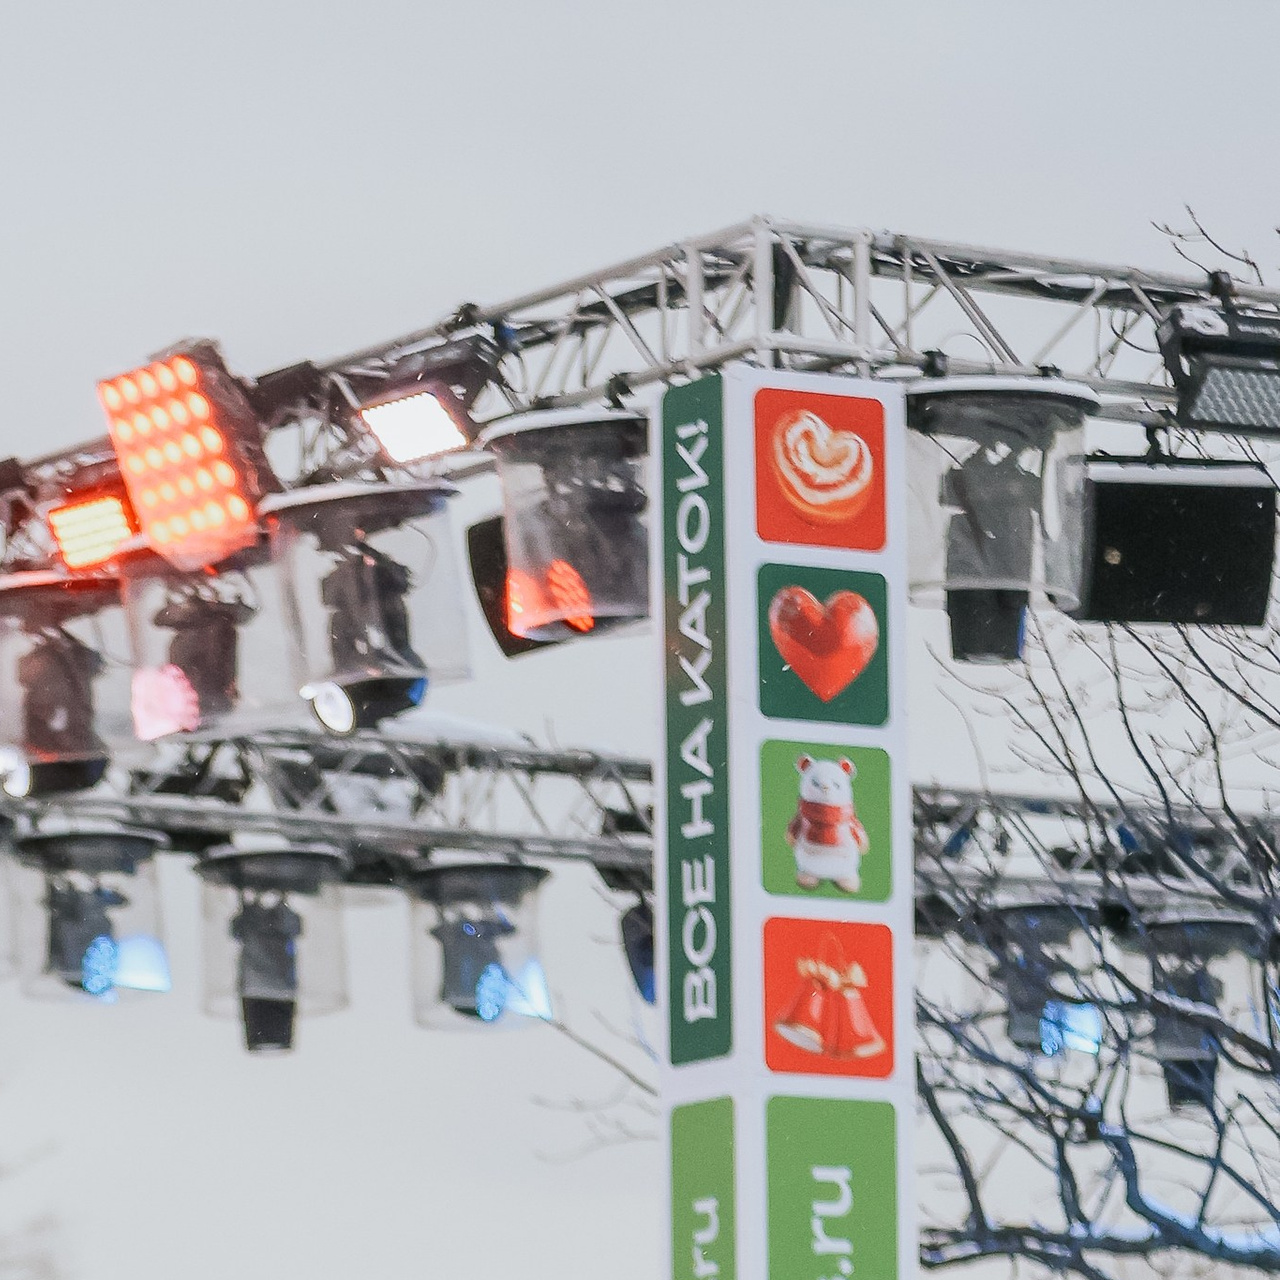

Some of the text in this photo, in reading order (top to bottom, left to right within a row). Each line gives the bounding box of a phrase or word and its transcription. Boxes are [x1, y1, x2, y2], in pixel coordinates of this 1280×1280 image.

[675, 417, 719, 1025] ВСЕ НА КАТОК!
